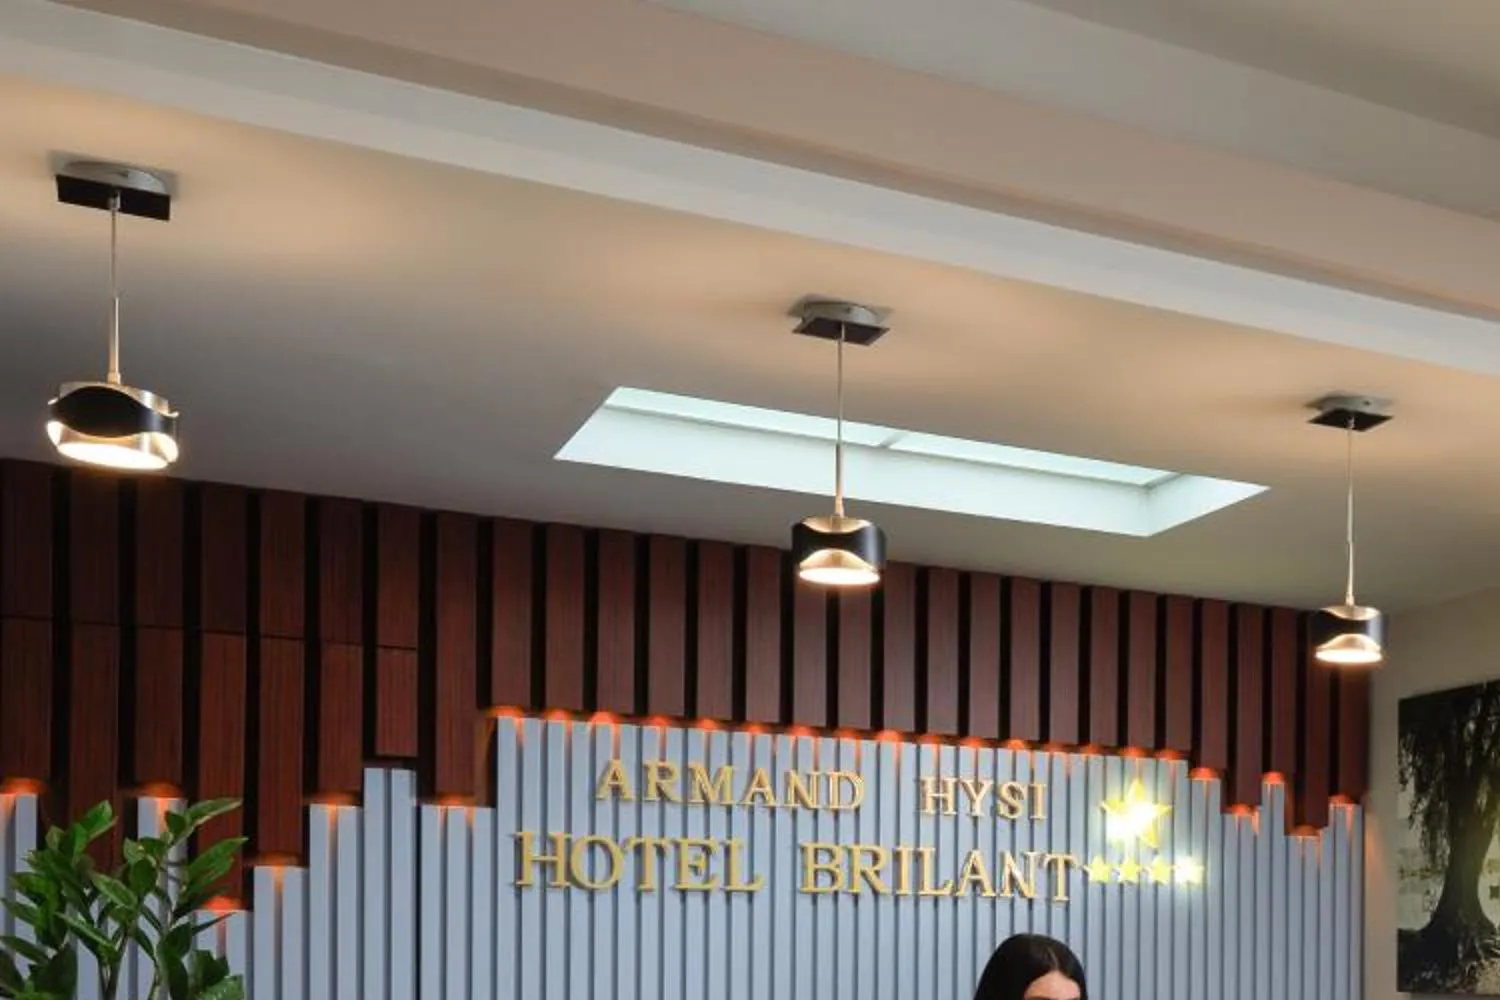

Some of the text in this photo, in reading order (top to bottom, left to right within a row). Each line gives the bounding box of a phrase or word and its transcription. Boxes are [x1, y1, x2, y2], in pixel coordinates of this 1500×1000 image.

[597, 757, 1048, 821] ARMAND HYSI
[514, 830, 1078, 903] HOTEL BRILANT
